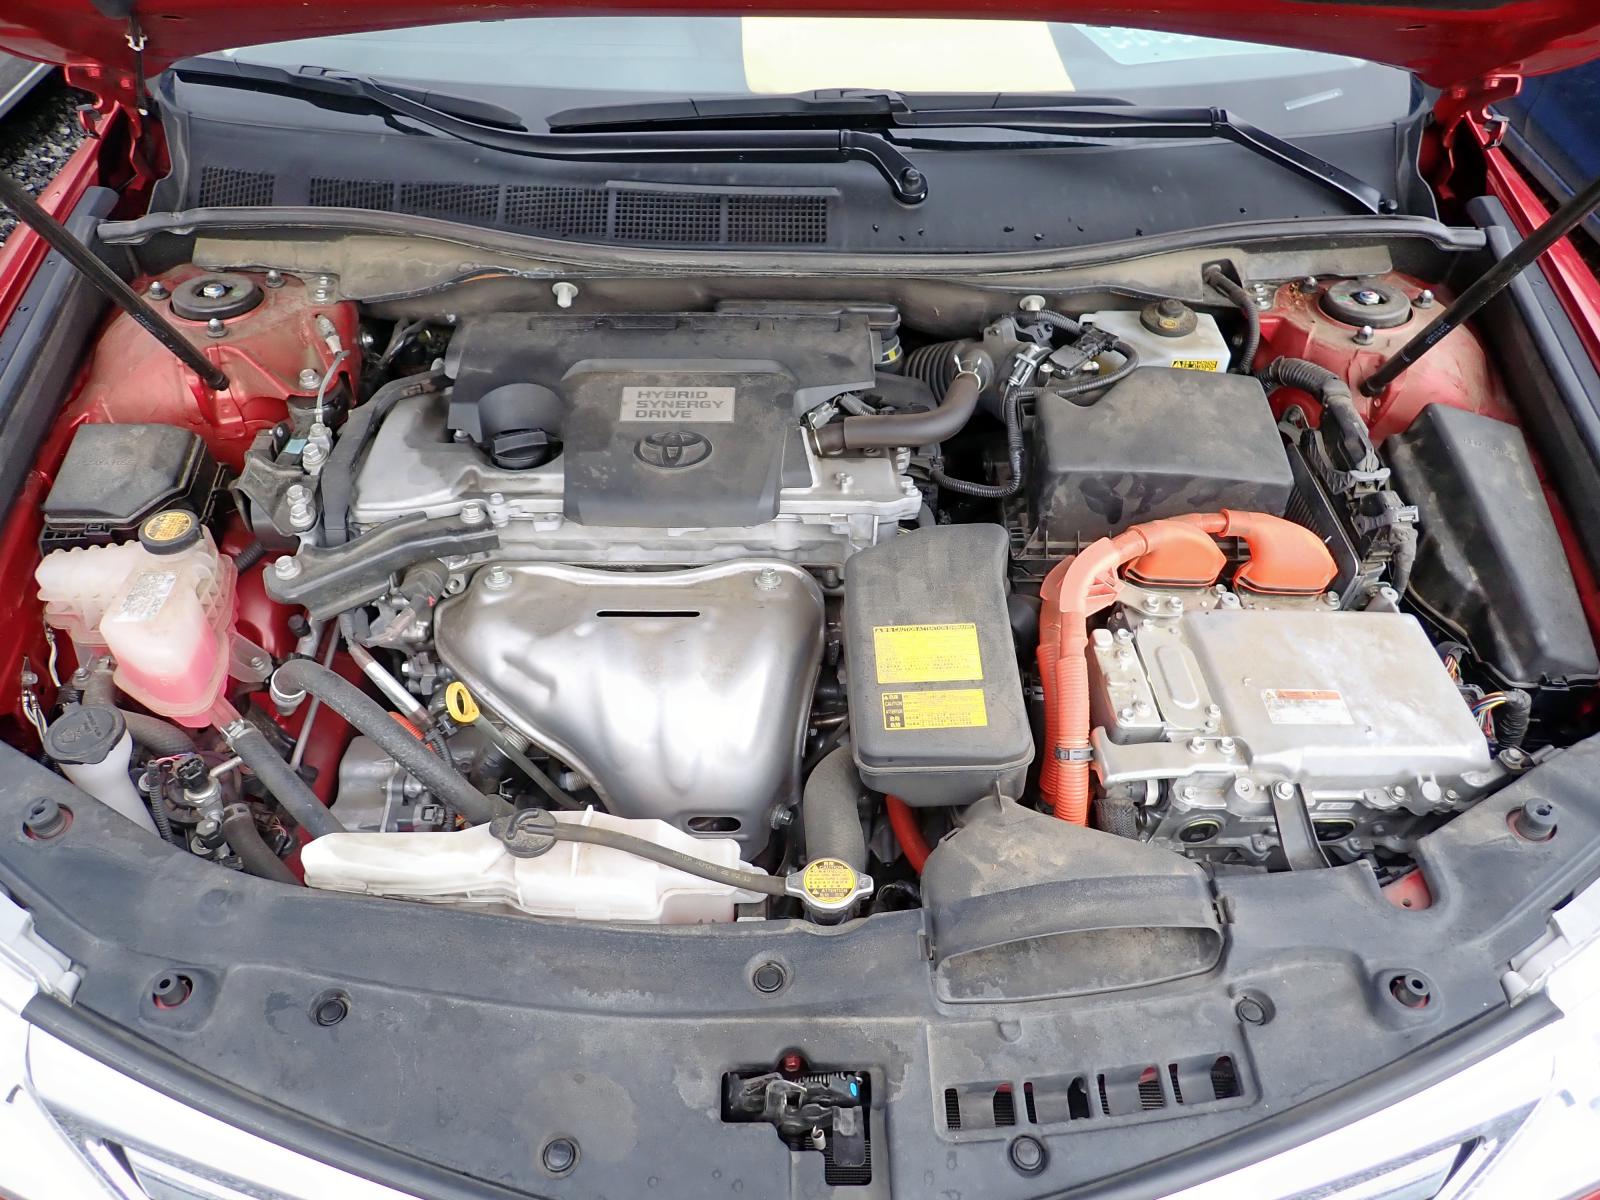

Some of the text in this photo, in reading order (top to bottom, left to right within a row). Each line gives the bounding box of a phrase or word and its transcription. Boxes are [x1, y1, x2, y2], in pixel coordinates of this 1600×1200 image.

[637, 390, 708, 399] HYBRID
[636, 400, 725, 409] SYNERGY
[635, 409, 693, 418] DRIVE
